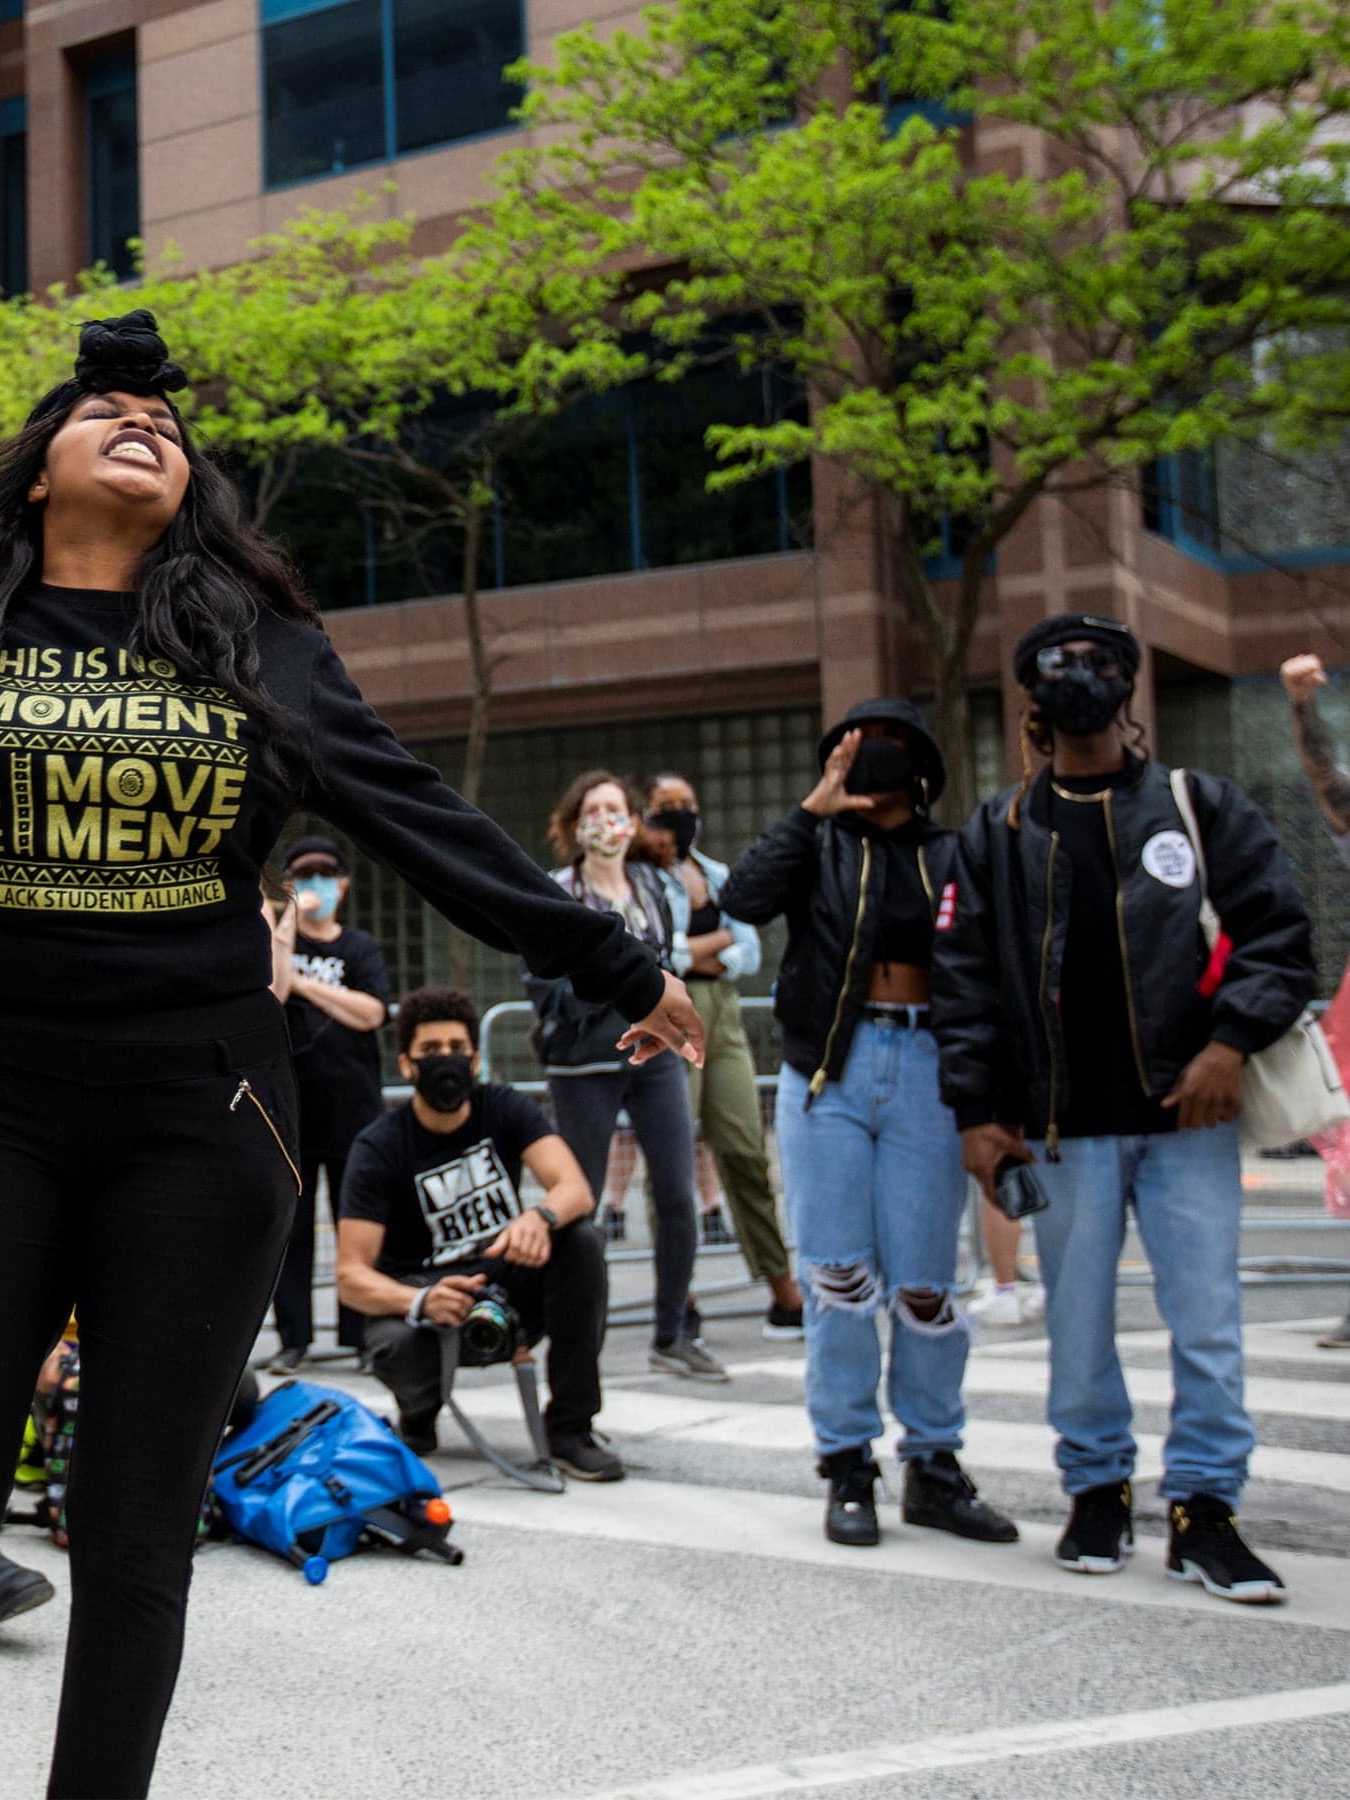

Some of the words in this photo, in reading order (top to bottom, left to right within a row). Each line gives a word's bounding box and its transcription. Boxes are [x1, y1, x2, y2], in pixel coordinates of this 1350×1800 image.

[73, 647, 109, 679] IS
[118, 647, 178, 678] NO
[46, 754, 247, 816] MOVE
[46, 805, 237, 862] MENT
[44, 890, 137, 910] STUDENT
[142, 882, 221, 909] ALLIANCE
[422, 1145, 500, 1210] WE
[438, 1186, 511, 1242] BEEN
